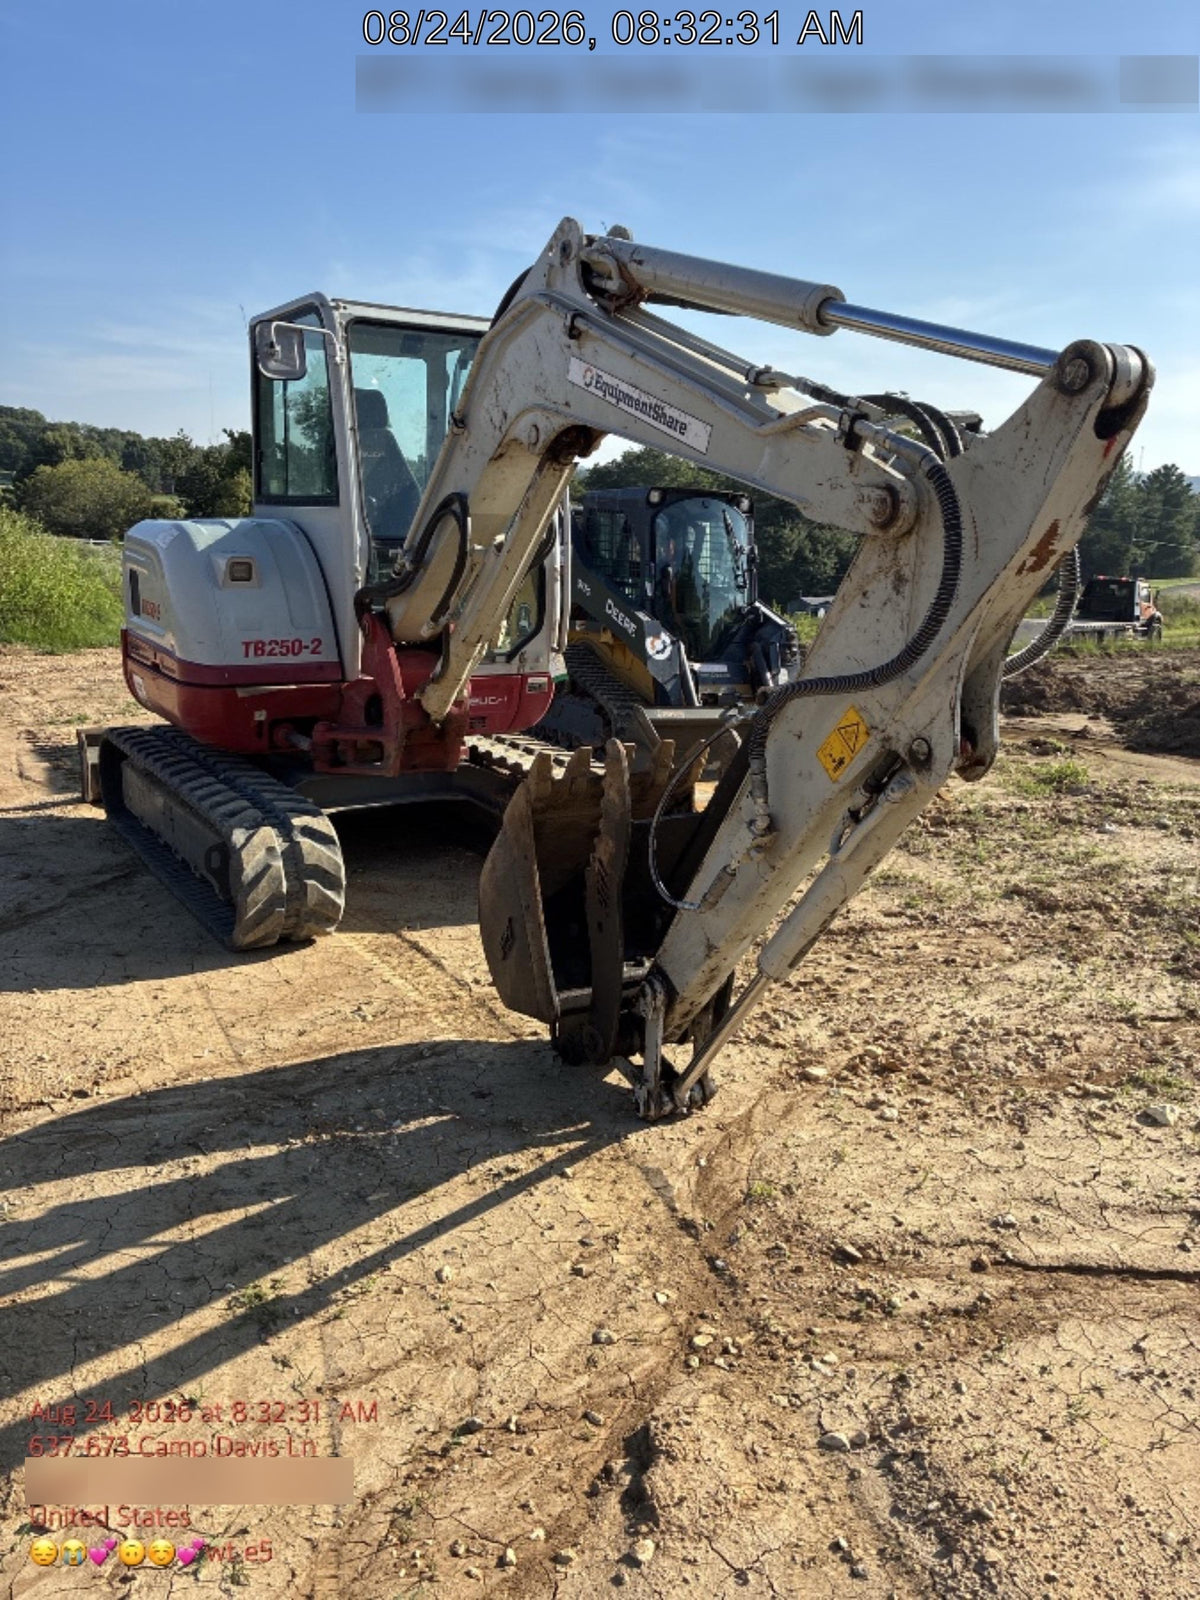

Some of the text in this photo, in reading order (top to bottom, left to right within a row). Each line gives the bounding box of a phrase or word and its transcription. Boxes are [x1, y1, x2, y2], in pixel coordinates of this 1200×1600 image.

[594, 373, 688, 436] EquipmentShare
[605, 598, 637, 638] DEERE
[241, 638, 323, 658] TB250-2
